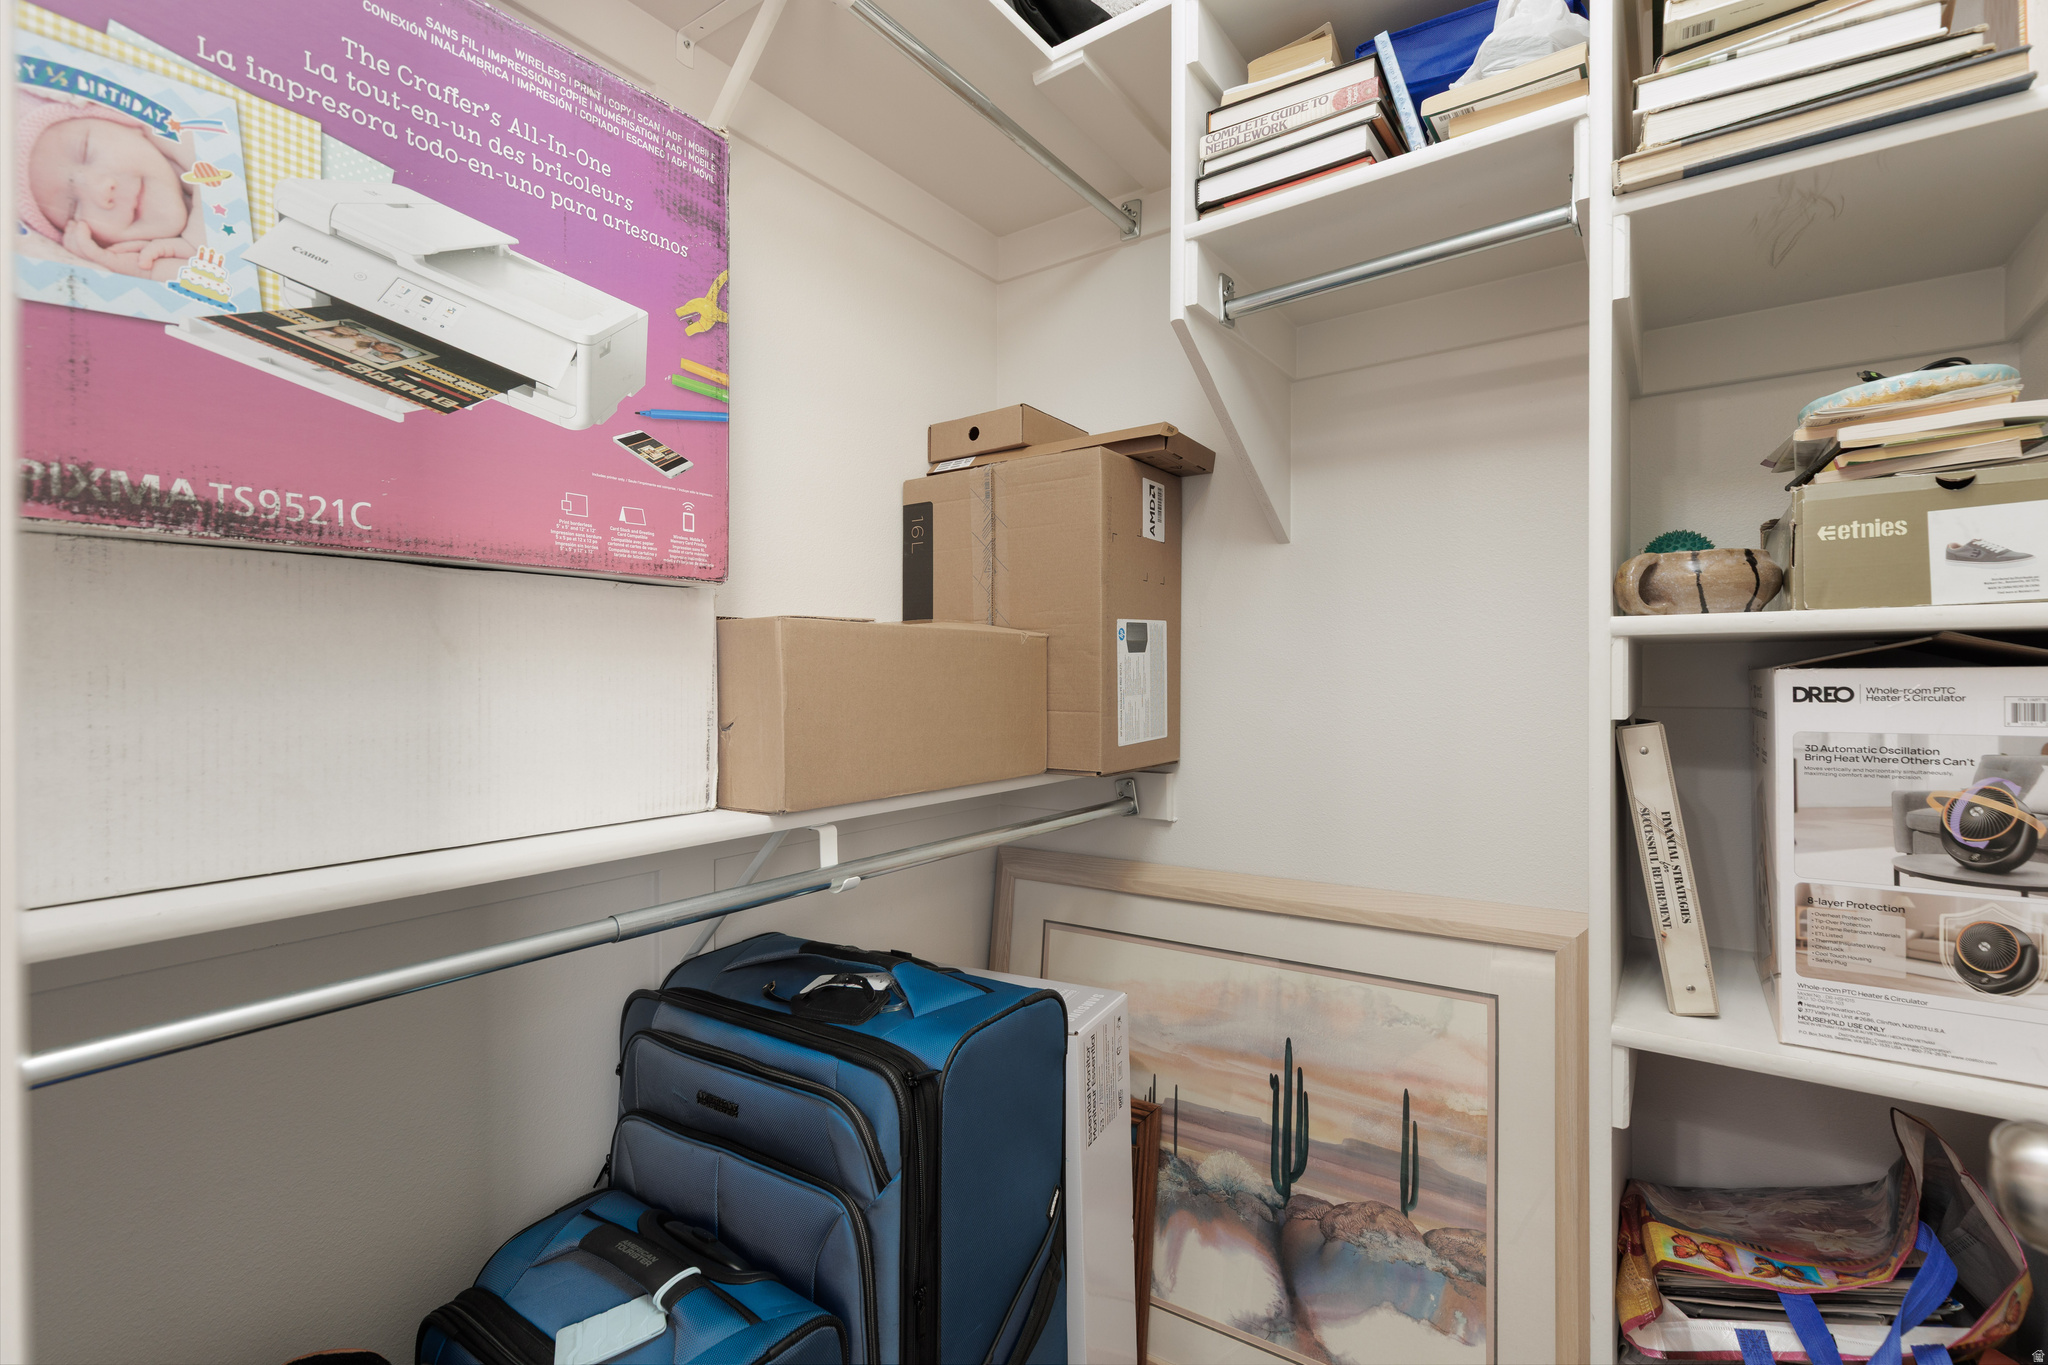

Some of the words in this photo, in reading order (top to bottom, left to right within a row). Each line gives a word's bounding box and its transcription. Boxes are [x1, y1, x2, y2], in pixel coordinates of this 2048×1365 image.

[77, 76, 166, 124] BIRTHDAY
[362, 0, 428, 41] CONEXIÓN
[430, 33, 509, 82] INALÁMBRICA
[517, 79, 572, 113] IMPRESIÓN
[579, 109, 620, 136] COPIADO
[671, 153, 688, 168] ADF
[692, 164, 716, 184] MÓVIL
[425, 16, 459, 41] SANS
[461, 34, 479, 53] FIL
[488, 47, 552, 90] IMPRESSION
[559, 85, 588, 108] COPIE
[594, 102, 660, 146] NUMÉRISATION
[665, 140, 682, 156] AAD
[688, 150, 716, 173] MOBILE
[514, 47, 567, 83] WIRELESS
[574, 79, 602, 101] PRINT
[608, 98, 632, 117] COPY
[637, 113, 661, 132] SCAN
[666, 129, 683, 143] ADF
[341, 36, 390, 76] The
[507, 117, 612, 178] All-In-One
[303, 50, 338, 83] La
[346, 69, 483, 147] tout-en-un
[488, 137, 525, 165] des
[531, 153, 634, 212] bricoleurs
[1204, 117, 1270, 145] COMPLETE
[1270, 103, 1310, 128] GUIDE
[1312, 94, 1330, 108] TO
[196, 35, 237, 71] La
[245, 55, 399, 140] impresora
[405, 127, 546, 200] todo-en-uno
[550, 189, 598, 223] para
[602, 210, 689, 258] artesanos
[1204, 119, 1289, 155] NEEDLEWORK
[290, 245, 330, 266] Canon
[349, 363, 457, 407] SMILE
[208, 481, 373, 530] TS9521C
[911, 515, 924, 554] 16L
[1837, 517, 1908, 541] etnies
[1792, 686, 1855, 703] DREO
[1866, 686, 1932, 695] Whole-room
[1933, 686, 1956, 695] PTC
[1866, 694, 1902, 702] Heater
[1903, 694, 1911, 702] &
[1912, 694, 1967, 702] Circulator
[1804, 753, 1832, 764] Bring
[1834, 754, 1860, 763] Heat
[1862, 755, 1899, 764] Where
[1900, 756, 1941, 765] Others
[1820, 745, 1878, 754] Automatic
[1879, 746, 1940, 756] Oscillation
[1821, 766, 1851, 774] vertically
[1640, 807, 1659, 864] SUCCESSFUL
[1659, 860, 1671, 873] for
[1661, 811, 1678, 862] FINANCIAL
[1671, 865, 1691, 925] STRATEGIES
[1807, 896, 1844, 908] 8-layer
[1846, 900, 1906, 914] Protection
[1842, 914, 1872, 922] Protection
[1815, 957, 1834, 965] Safety
[1847, 954, 1872, 963] Housing
[1797, 982, 1841, 994] Whole-room
[1842, 988, 1857, 996] PTC
[1857, 991, 1883, 999] Heater
[1890, 995, 1928, 1006] Circulator
[1826, 1005, 1856, 1014] Innovation
[1797, 1014, 1845, 1027] HOUSEHOLD
[1847, 1021, 1864, 1029] USE
[1863, 1024, 1886, 1033] ONLY
[1085, 1045, 1093, 1092] Monitor
[1085, 1093, 1093, 1148] Essential
[614, 1242, 653, 1267] TOURISTER
[620, 1239, 660, 1263] AMERICAN
